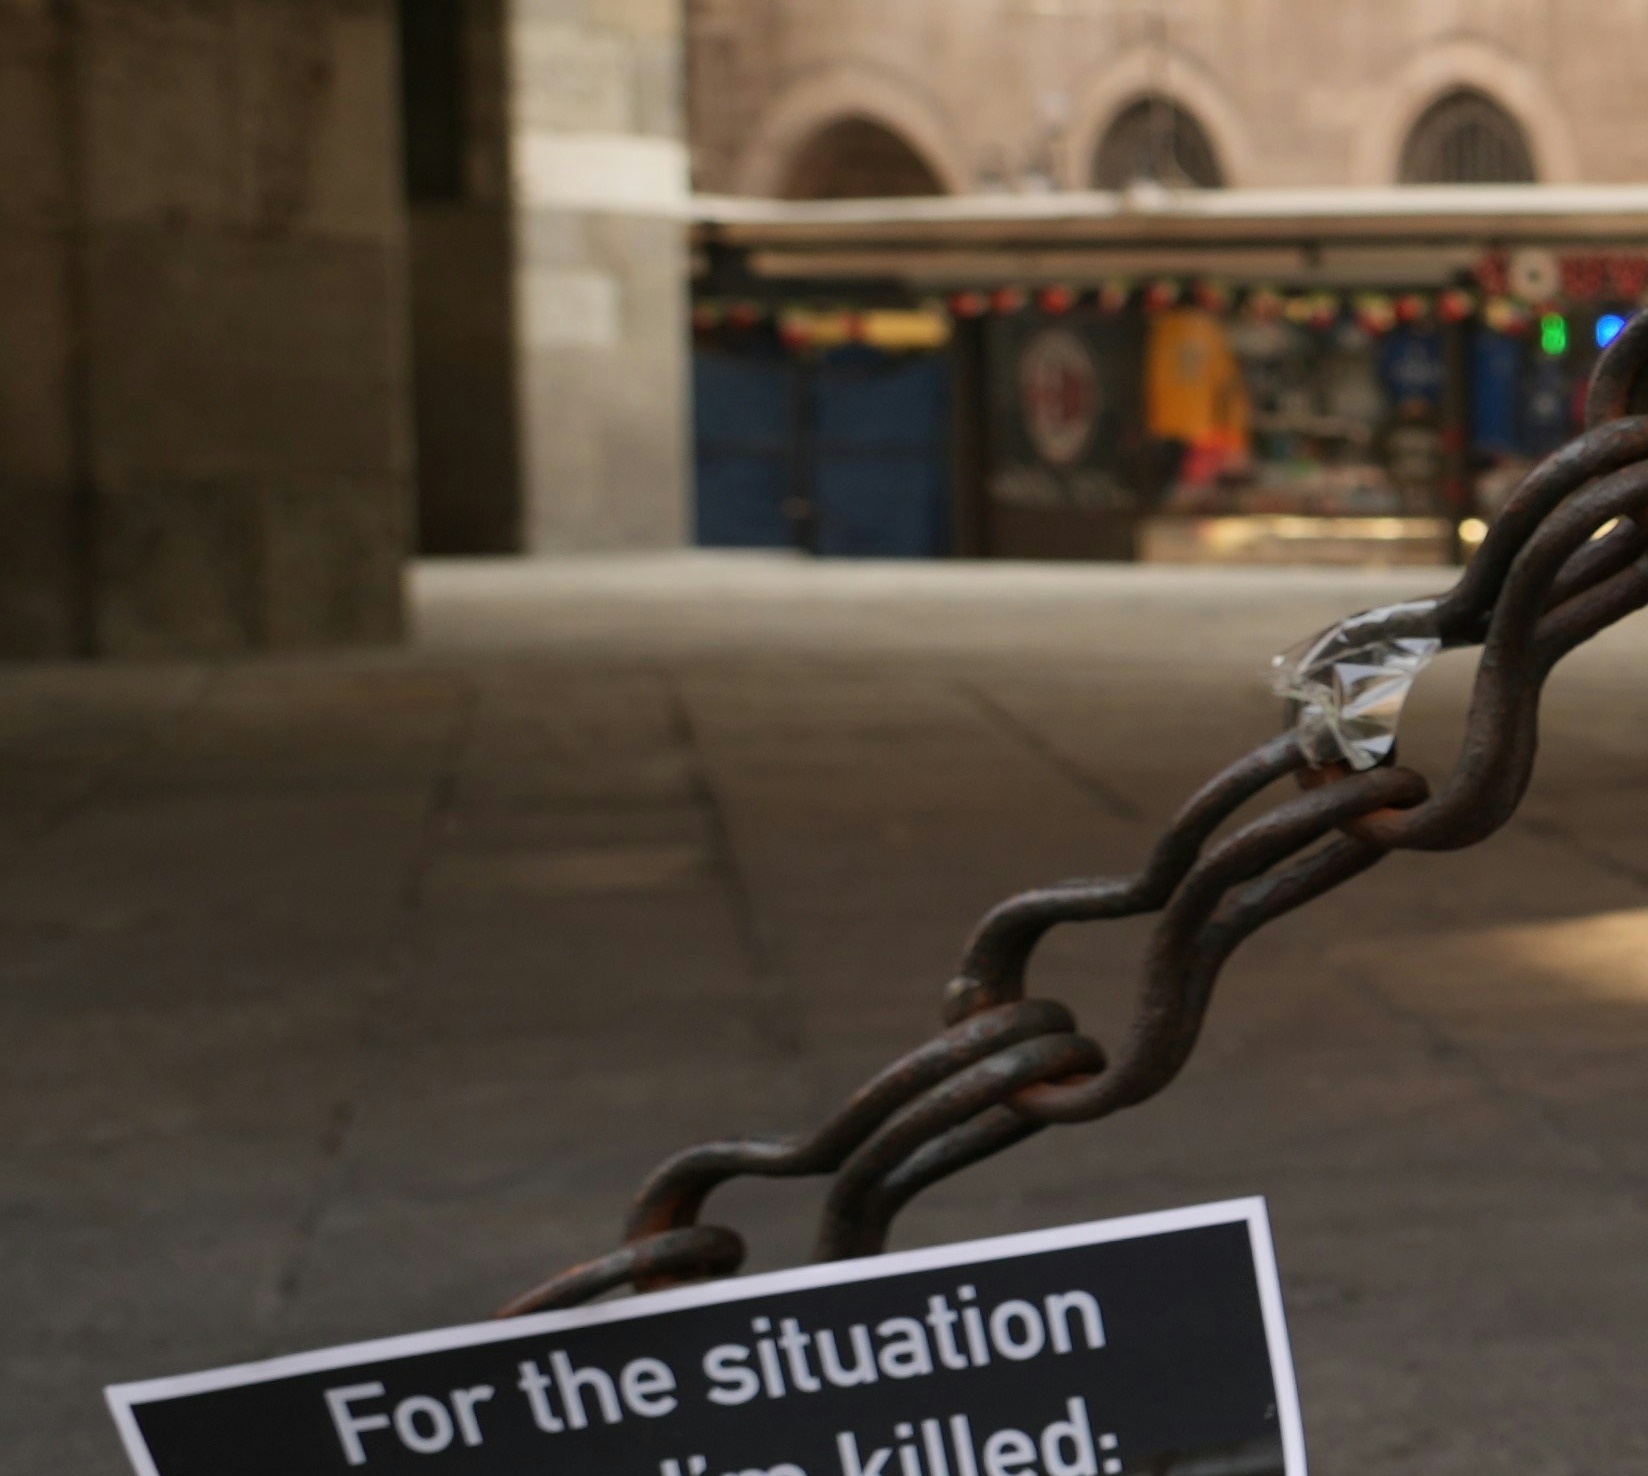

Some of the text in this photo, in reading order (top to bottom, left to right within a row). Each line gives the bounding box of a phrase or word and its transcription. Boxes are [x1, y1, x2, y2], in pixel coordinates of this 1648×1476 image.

[329, 1283, 1106, 1465] For the situation
